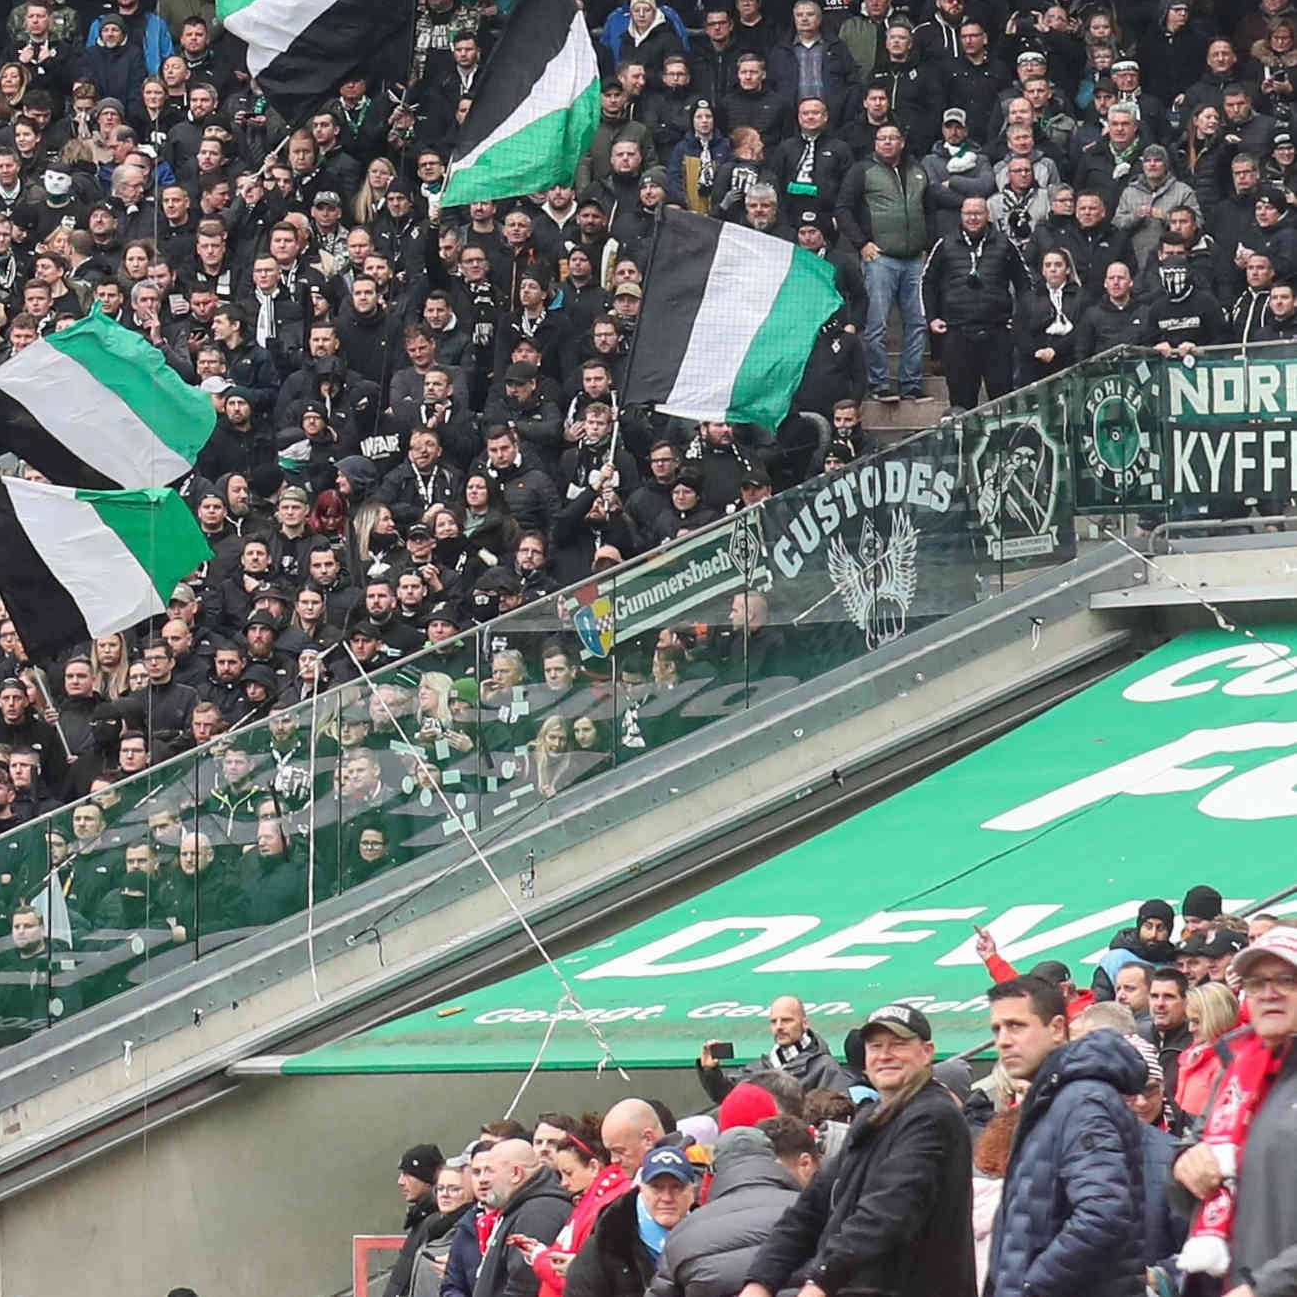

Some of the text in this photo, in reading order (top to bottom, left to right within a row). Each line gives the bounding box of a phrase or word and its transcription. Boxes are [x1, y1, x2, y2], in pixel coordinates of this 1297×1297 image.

[1172, 430, 1297, 494] KYFF
[773, 460, 955, 580] CUSTODES
[612, 545, 733, 620] Gummersbach
